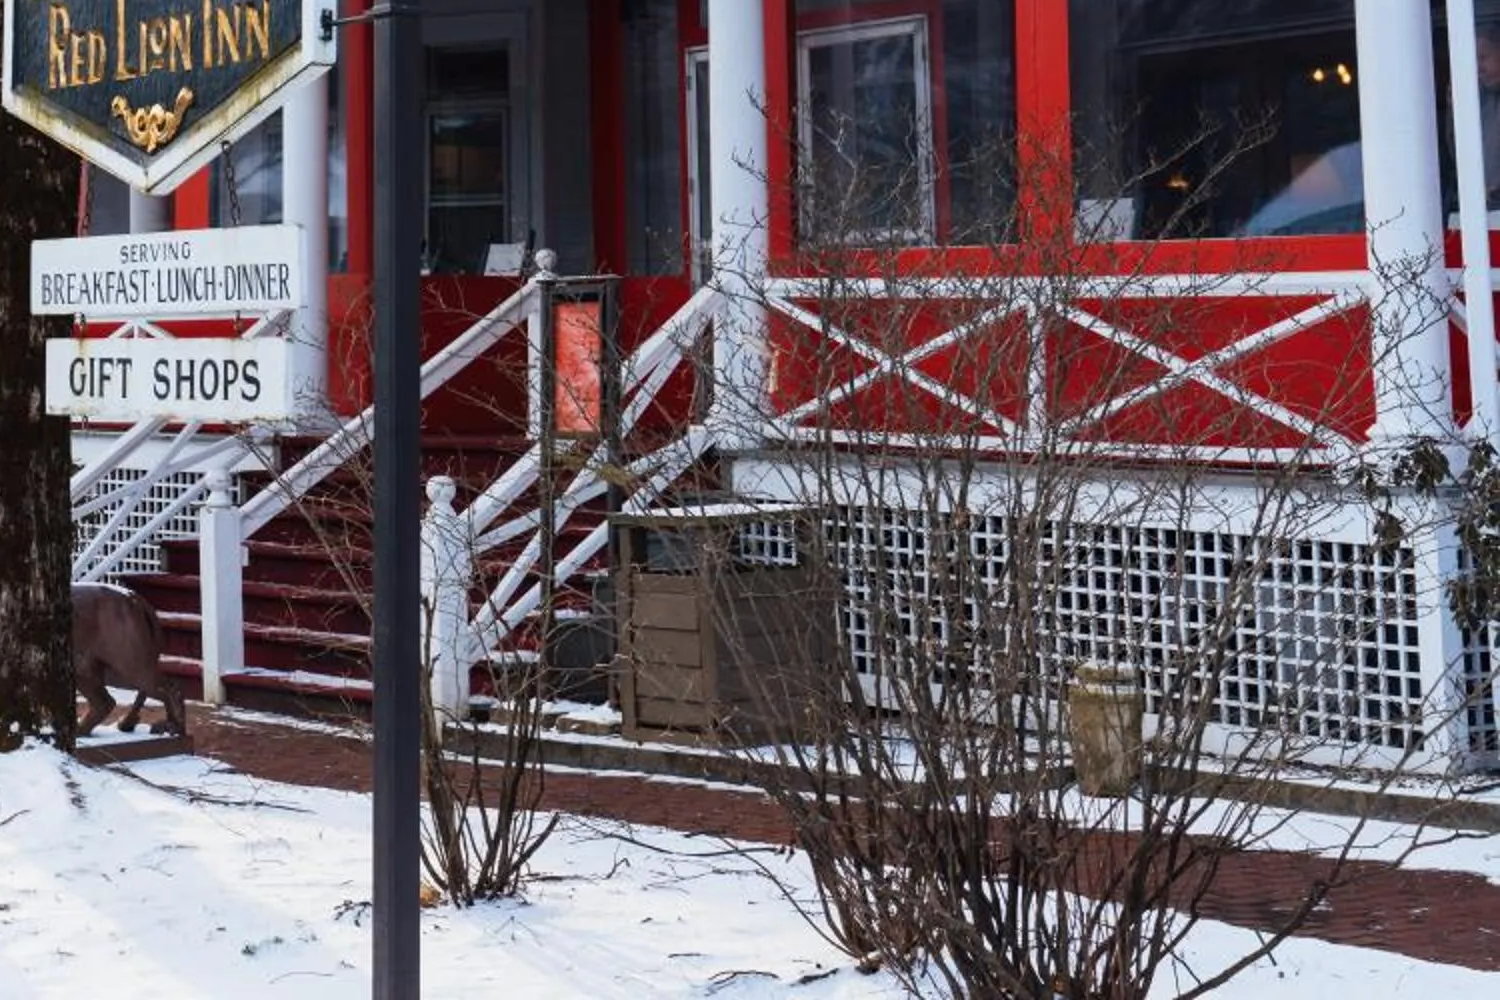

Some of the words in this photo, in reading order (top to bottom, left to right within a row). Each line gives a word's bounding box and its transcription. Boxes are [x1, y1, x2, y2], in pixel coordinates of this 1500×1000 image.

[48, 3, 106, 89] RED
[120, 242, 191, 264] SERVING
[69, 357, 132, 400] GIFT
[153, 357, 261, 401] SHOPS
